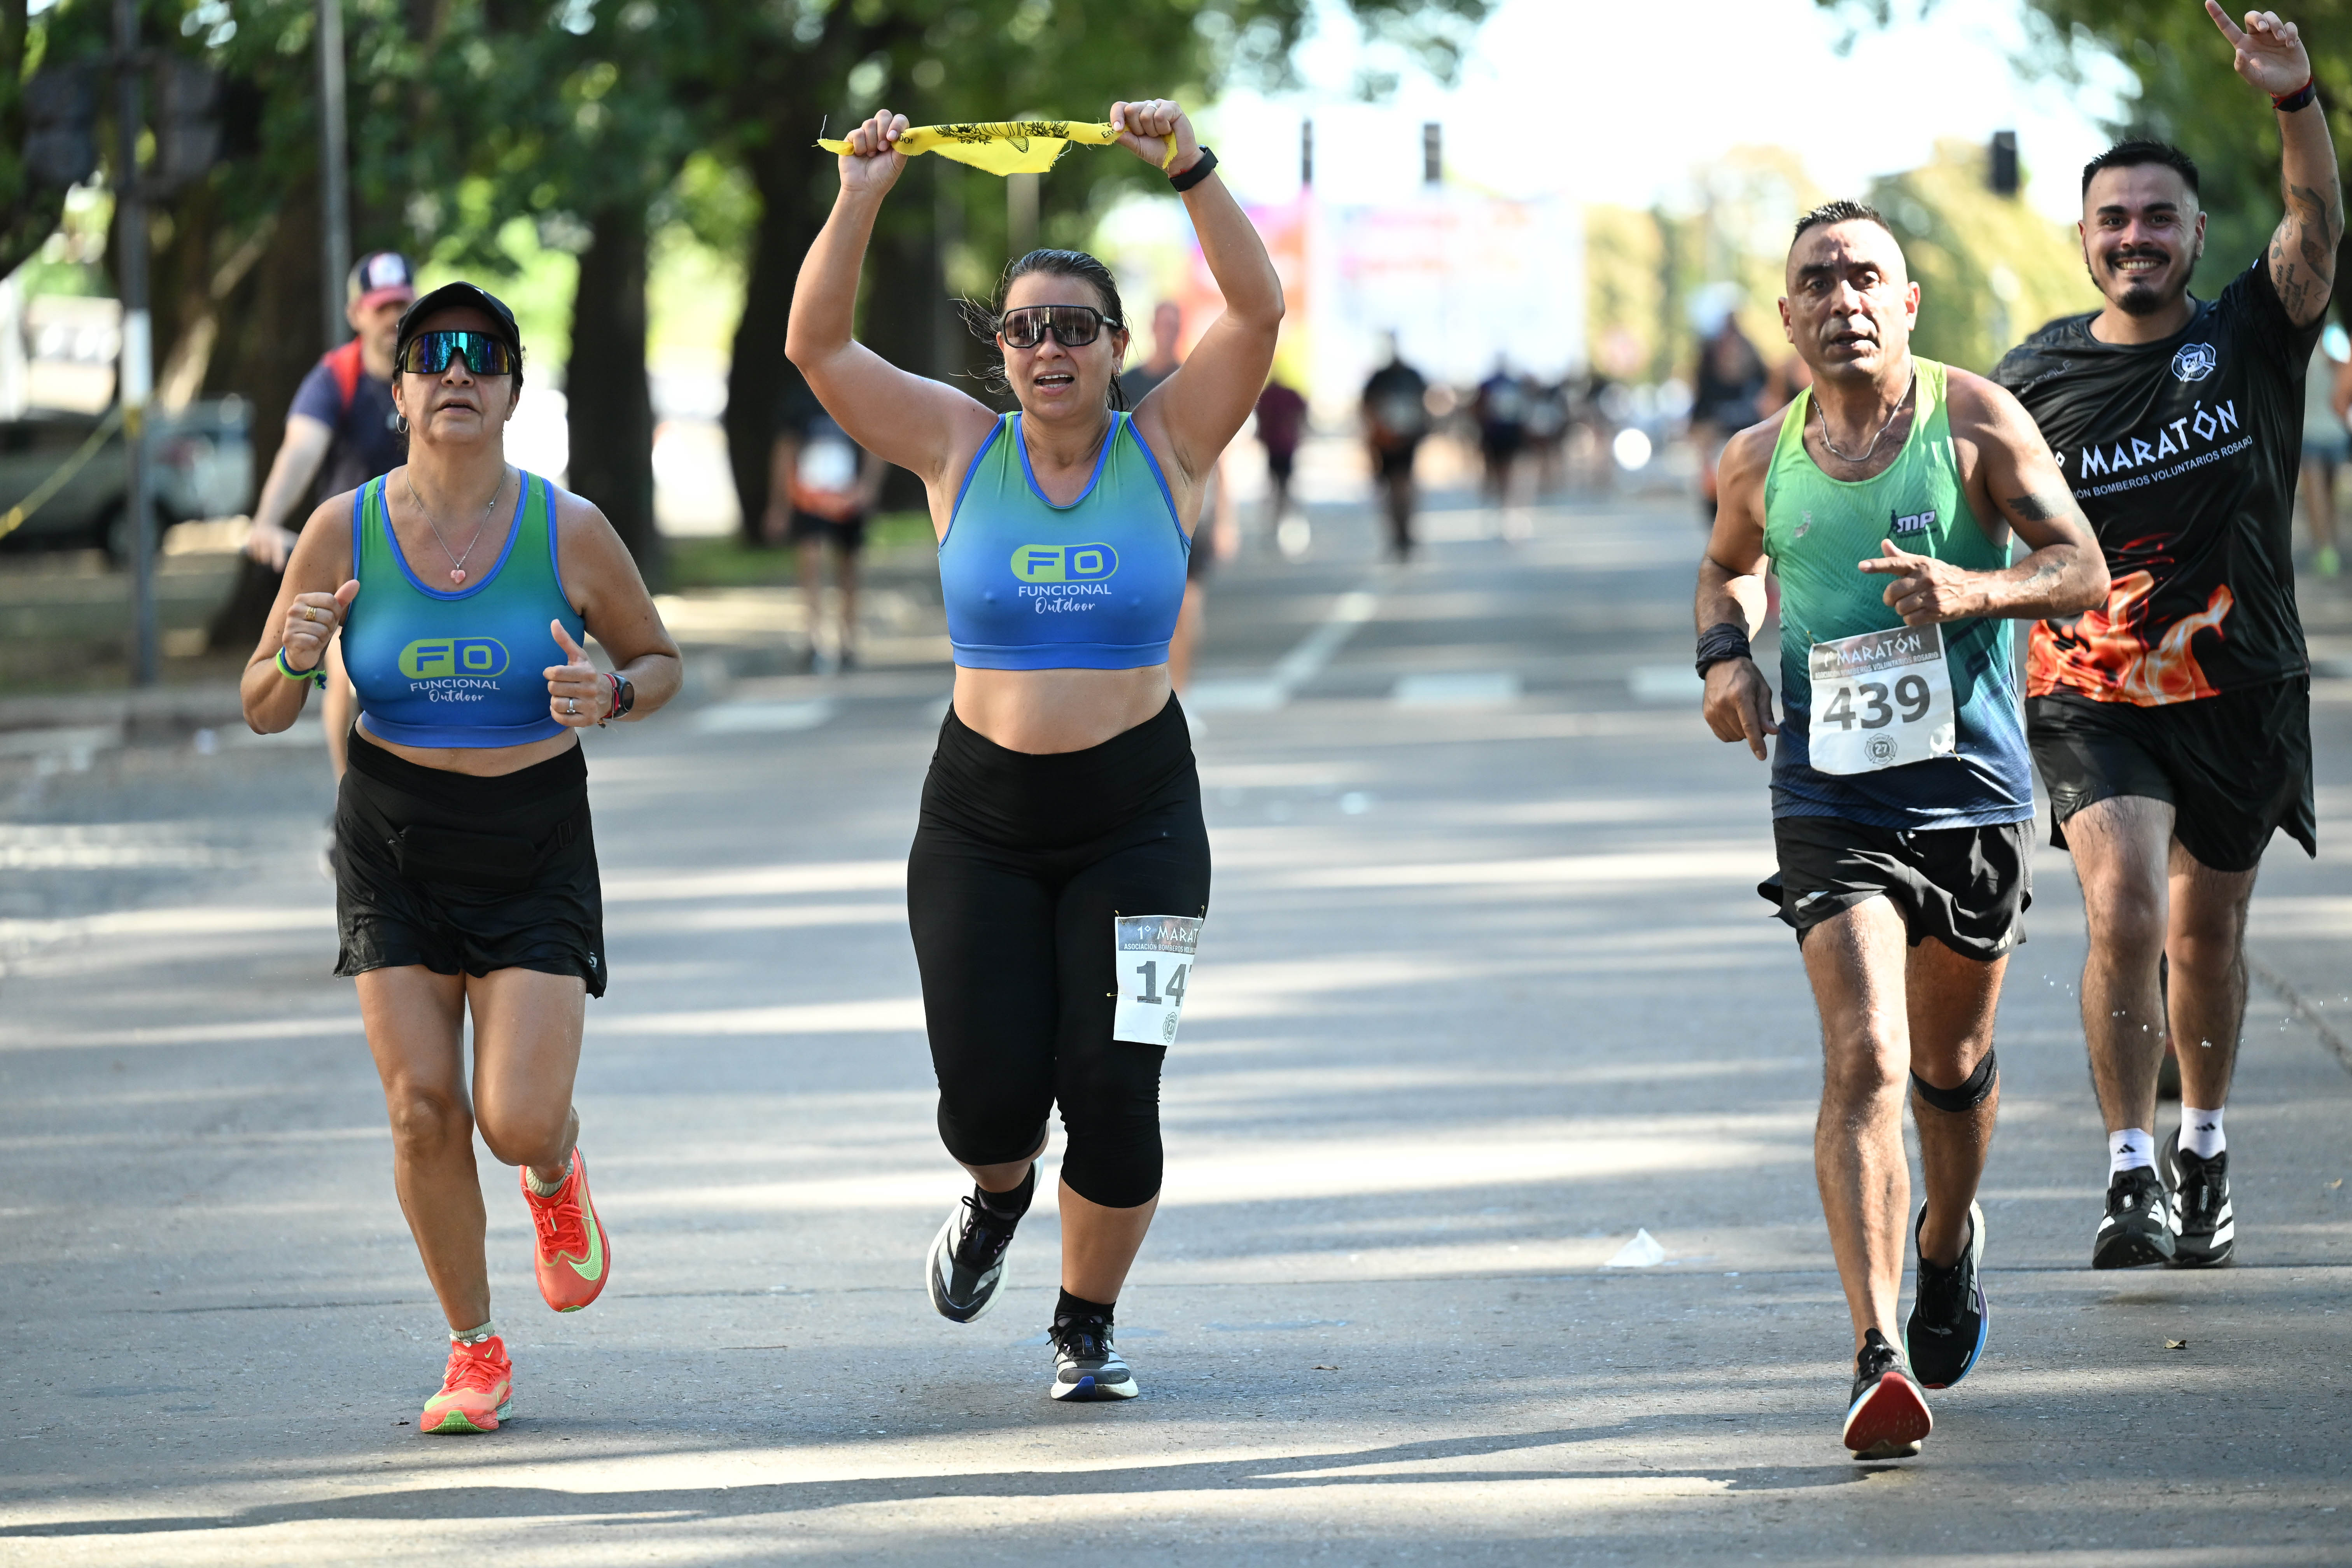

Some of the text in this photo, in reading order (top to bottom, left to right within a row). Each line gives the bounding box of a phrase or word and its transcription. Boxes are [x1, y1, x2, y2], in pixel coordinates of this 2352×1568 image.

[2081, 399, 2239, 480] MARATÓN
[2073, 487, 2092, 500] IÓN
[2092, 474, 2150, 497] BOMBEROS
[2151, 450, 2220, 483] VOLUNTARIOS
[1018, 584, 1112, 597] FUNCIONAL
[1035, 597, 1096, 614] Outdoor
[1836, 632, 1922, 666] MARATÓN
[1872, 656, 1912, 670] VOLUNTARIOS
[1913, 651, 1939, 663] ROSARIO
[410, 678, 500, 692] FUNCIONAL
[429, 689, 485, 702] Outdoor
[1823, 674, 1931, 731] 439
[1874, 743, 1887, 754] 27
[1157, 924, 1199, 943] MARAT
[1124, 942, 1157, 950] ASOCIACIÓN
[1158, 943, 1183, 953] BOMBEROS
[1136, 961, 1193, 1007] 14
